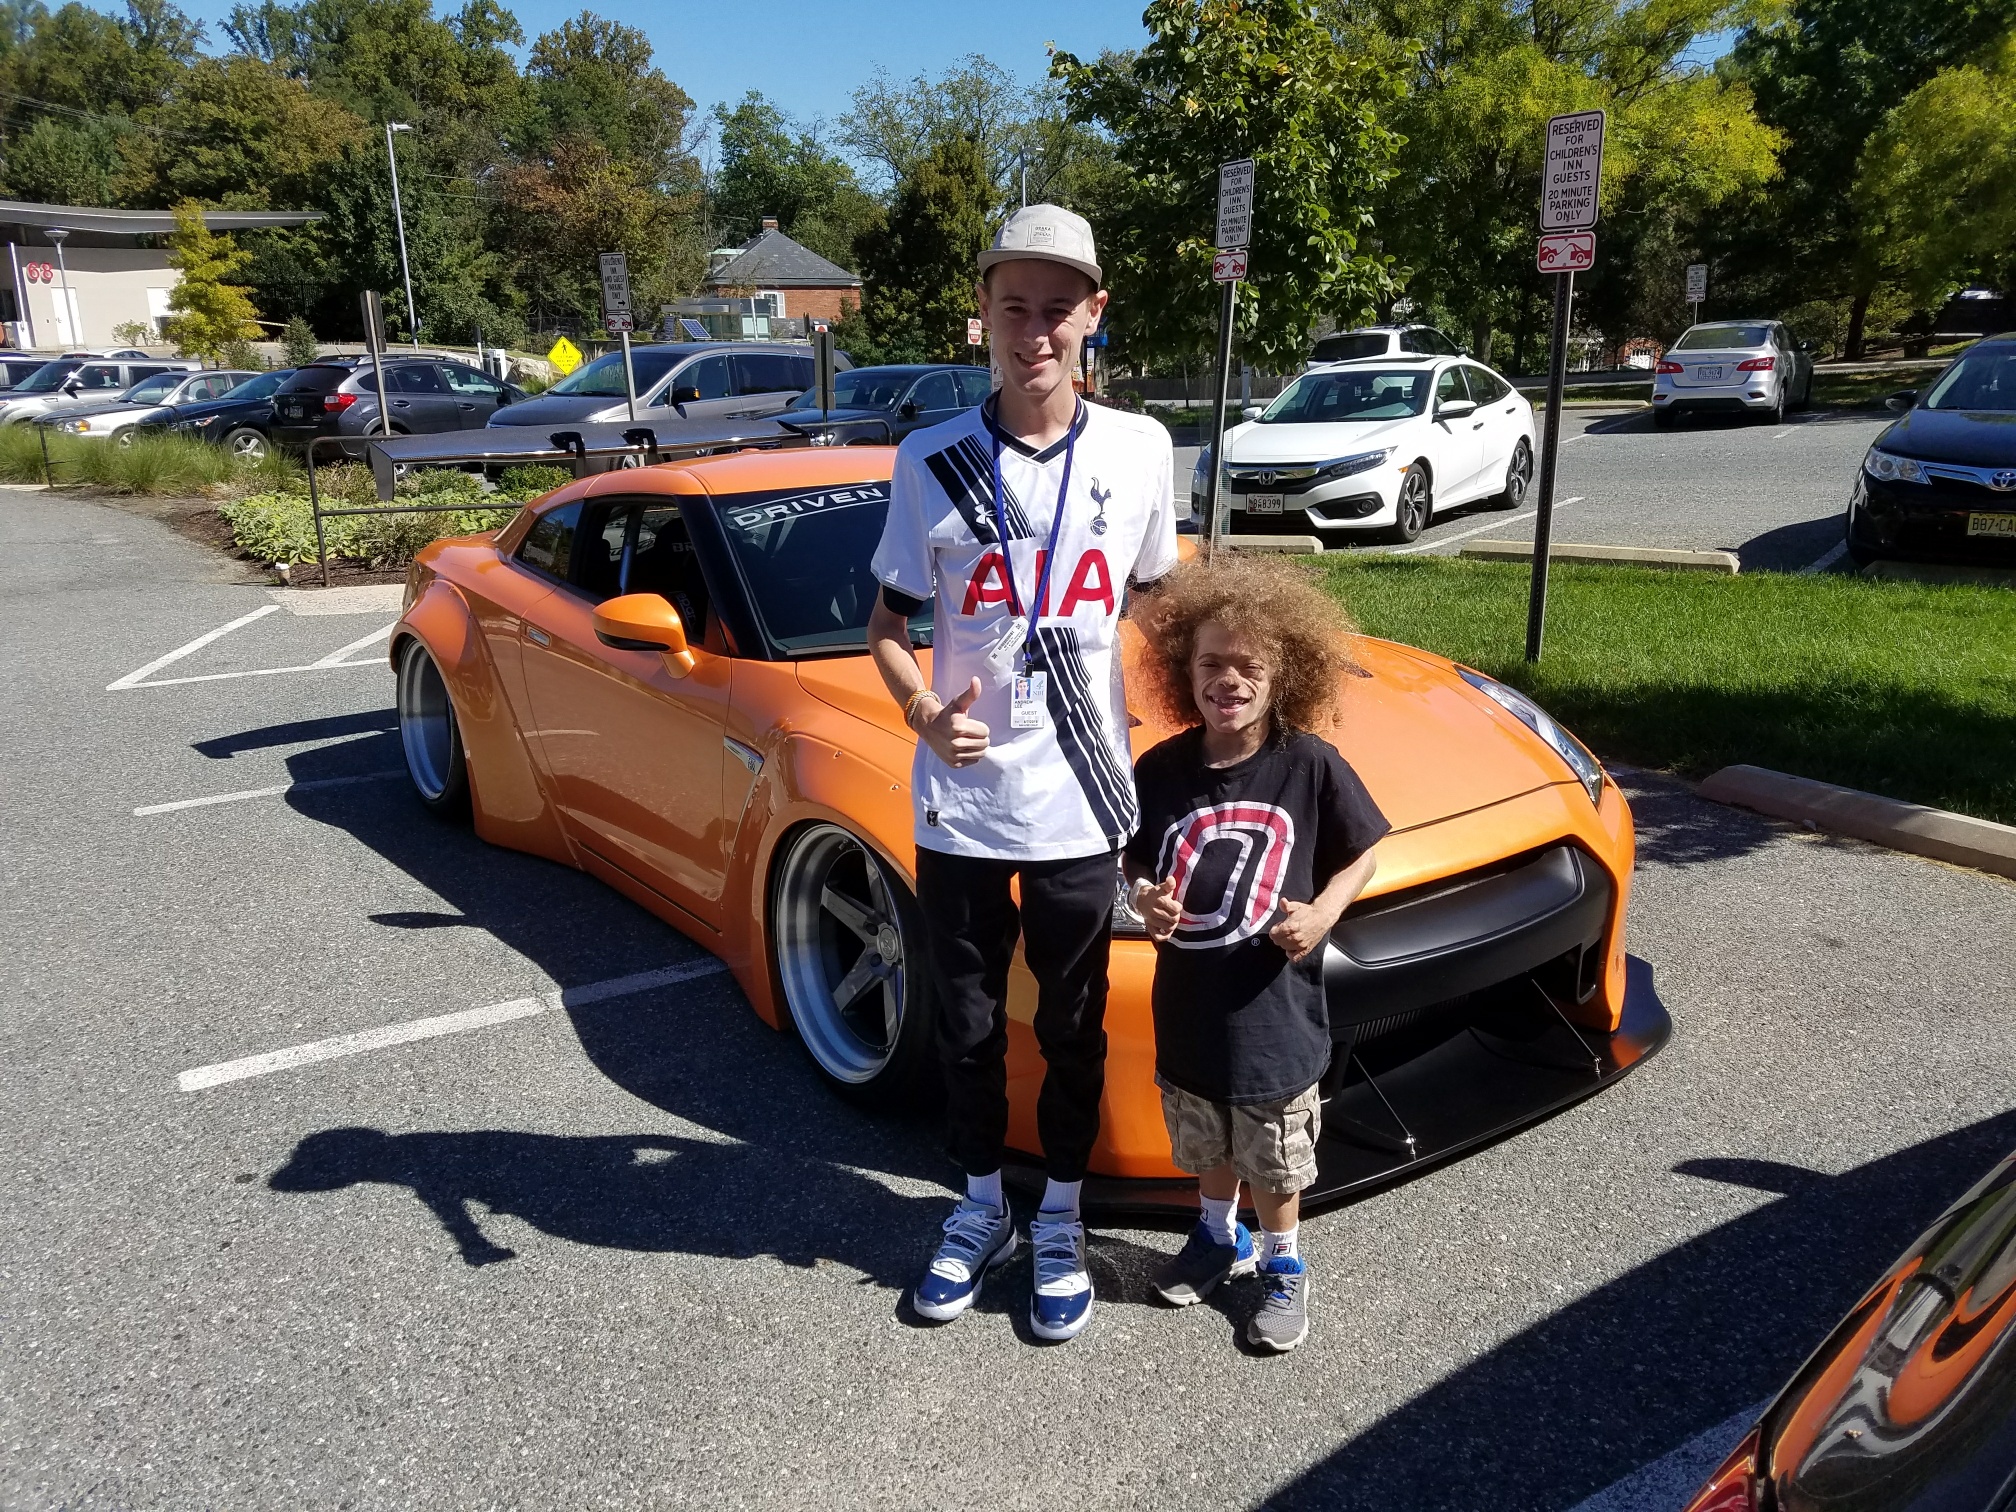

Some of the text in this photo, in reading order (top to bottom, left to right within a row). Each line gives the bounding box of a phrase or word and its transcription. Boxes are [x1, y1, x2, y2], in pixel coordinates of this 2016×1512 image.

[1552, 119, 1600, 136] RESERVED
[1565, 135, 1584, 146] FOR
[1550, 144, 1598, 160] CHILDREN'S
[1563, 159, 1583, 171] INN
[1223, 165, 1251, 179] RESERVED
[1553, 170, 1590, 184] GUESTS
[1231, 178, 1242, 187] FOR
[1222, 184, 1250, 197] CHILDREN'S
[1548, 186, 1592, 200] 20 MINUTE
[1229, 195, 1241, 205] INN
[1549, 198, 1590, 211] PARKING
[1223, 204, 1246, 215] GUESTS
[1555, 210, 1582, 222] ONLY
[1220, 215, 1247, 227] 20 MINUTE
[1221, 224, 1246, 235] PARKING
[1224, 233, 1241, 243] ONLY
[28, 262, 54, 281] 68
[733, 488, 884, 527] DRIVEN
[961, 549, 1115, 617] AIA
